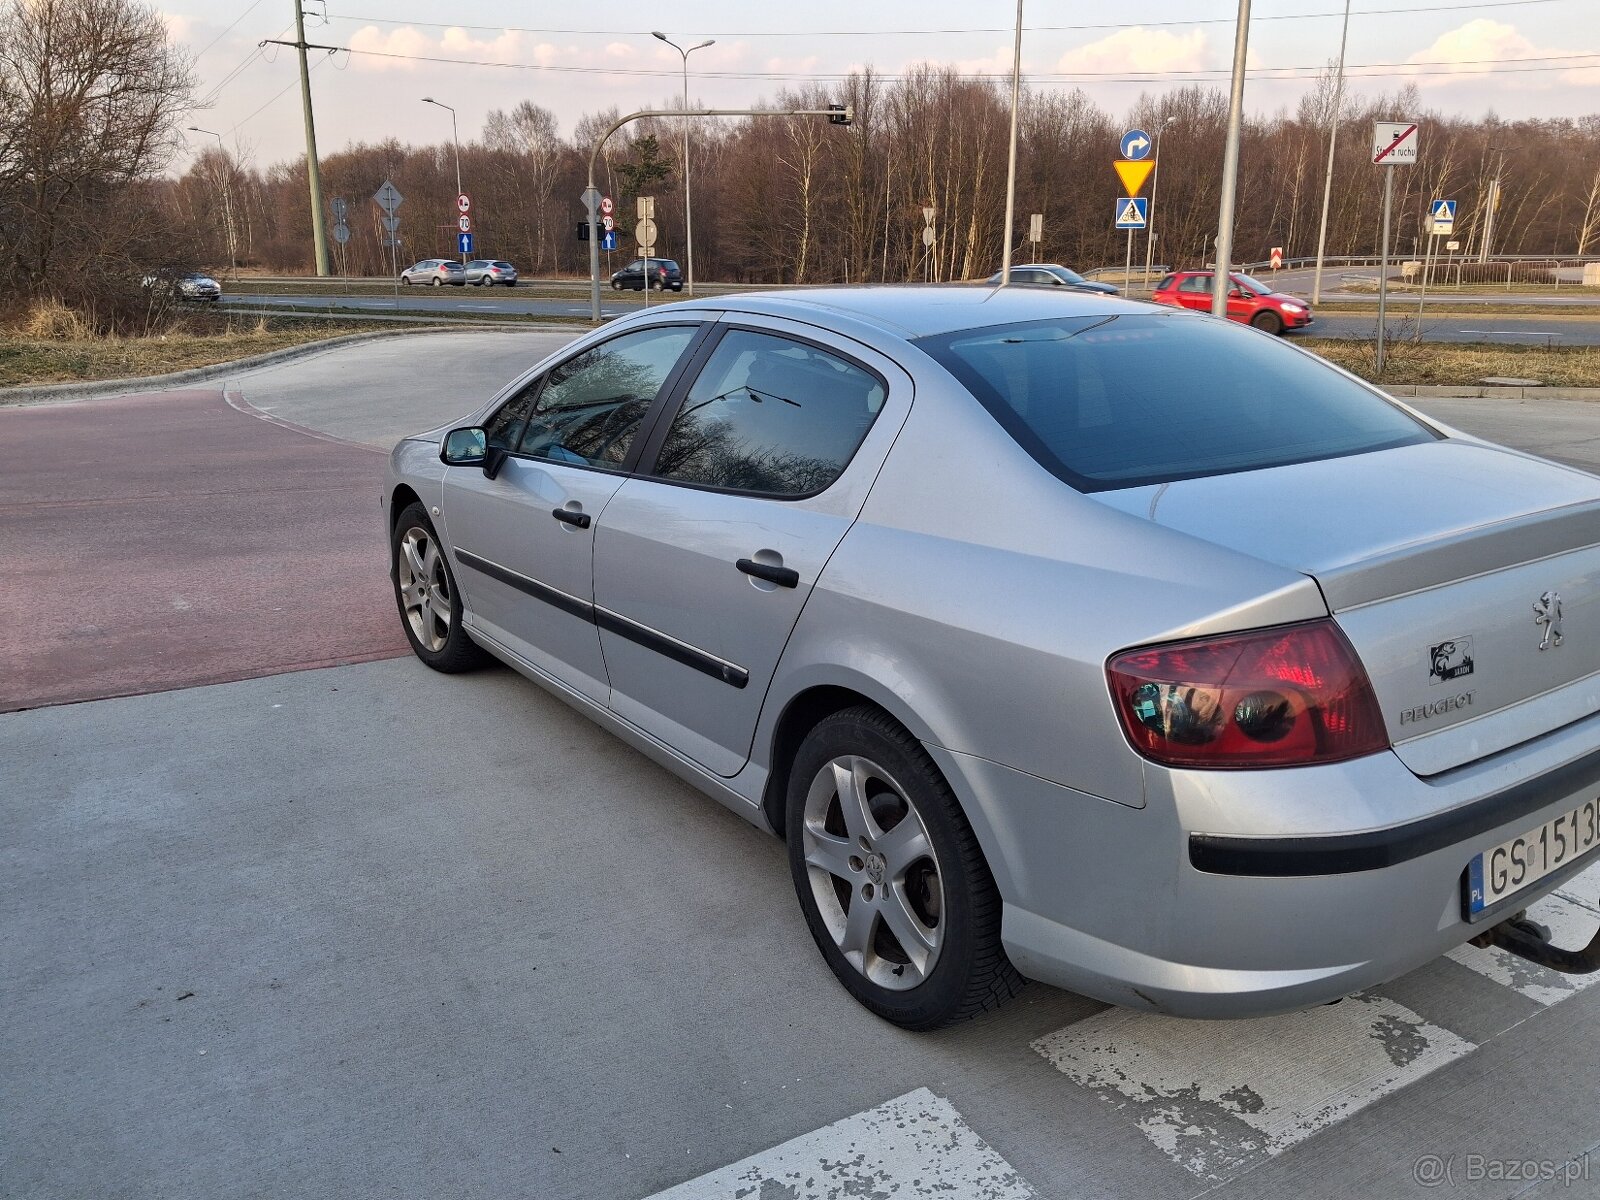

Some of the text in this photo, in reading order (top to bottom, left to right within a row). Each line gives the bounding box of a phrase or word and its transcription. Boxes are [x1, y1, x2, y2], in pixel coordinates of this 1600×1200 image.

[1397, 146, 1416, 156] ruchu
[460, 218, 469, 228] 70
[604, 218, 613, 228] 70
[1400, 689, 1477, 725] PEUGEOT
[1490, 838, 1526, 895] GS
[1471, 889, 1483, 903] PL
